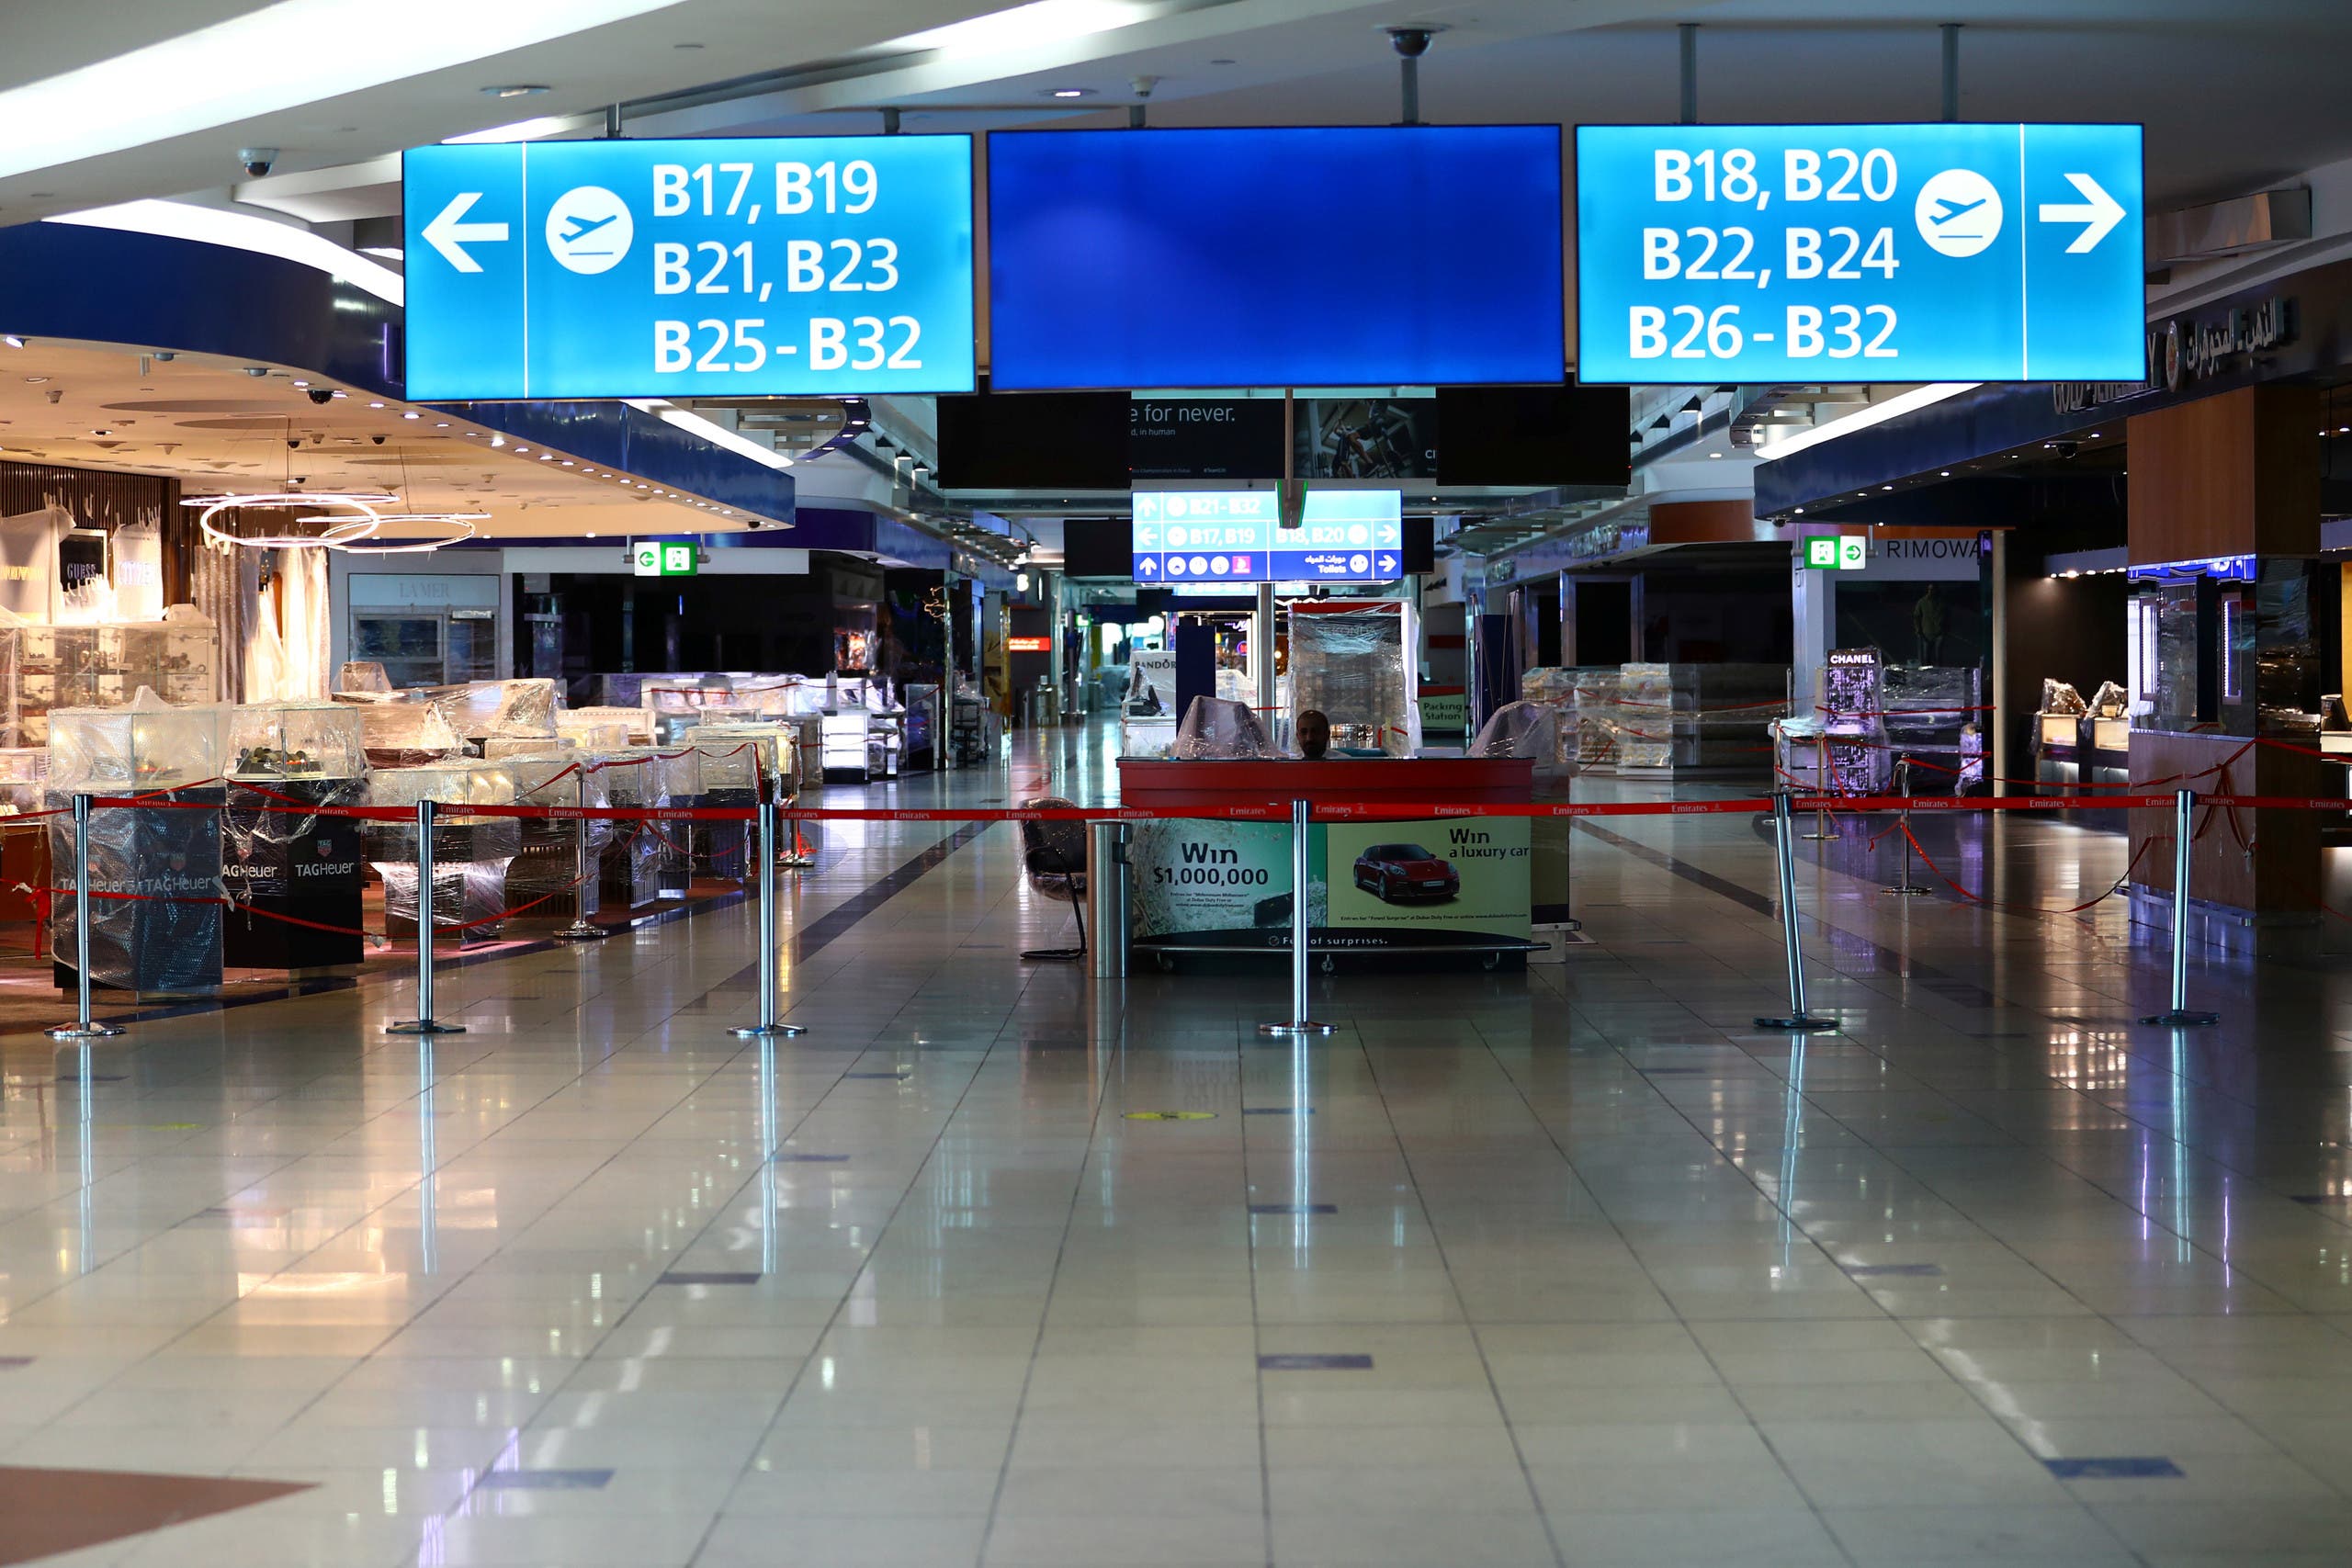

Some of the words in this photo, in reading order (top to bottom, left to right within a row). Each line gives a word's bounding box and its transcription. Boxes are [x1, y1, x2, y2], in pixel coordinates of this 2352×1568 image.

[1654, 148, 1770, 210] B18,
[1783, 147, 1898, 202] B20
[652, 163, 761, 224] B17,
[775, 160, 878, 216] B19
[1642, 226, 1772, 288] B22,
[1785, 226, 1900, 279] B24
[653, 241, 773, 302] B21,
[786, 238, 899, 293] B23
[1145, 404, 1172, 422] for
[1179, 408, 1235, 422] never.
[1190, 528, 1223, 546] B17,
[1225, 528, 1255, 544] B19
[1312, 527, 1344, 544] B20
[67, 563, 96, 580] GUESS
[1317, 565, 1347, 573] Toilets
[1830, 654, 1875, 664] CHANEL
[1423, 701, 1463, 716] Packing
[1425, 711, 1461, 721] Station
[1671, 804, 1708, 813] Emirates
[1795, 800, 1832, 808] Emirates
[1912, 799, 1949, 808] Emirates
[2030, 799, 2065, 808] Emirates
[2309, 800, 2346, 808] Emirates
[313, 807, 350, 816] Emirates
[441, 805, 475, 815] Emirates
[548, 808, 584, 818] Emirates
[658, 809, 694, 818] Emirates
[782, 809, 819, 818] Emirates
[893, 810, 931, 819] Emirates
[1005, 810, 1043, 819] Emirates
[1118, 808, 1154, 818] Emirates
[1230, 807, 1266, 816] Emirates
[1315, 806, 1352, 814] Emirates
[1433, 807, 1471, 815] Emirates
[1553, 807, 1589, 815] Emirates
[1449, 828, 1491, 844] Win
[1181, 841, 1238, 864] Win
[1449, 848, 1457, 858] a
[1461, 846, 1505, 861] luxury
[1510, 847, 1530, 858] car
[1153, 866, 1269, 886] $1,000,000
[61, 878, 126, 892] TAHeuer
[1327, 938, 1388, 946] surprises.
